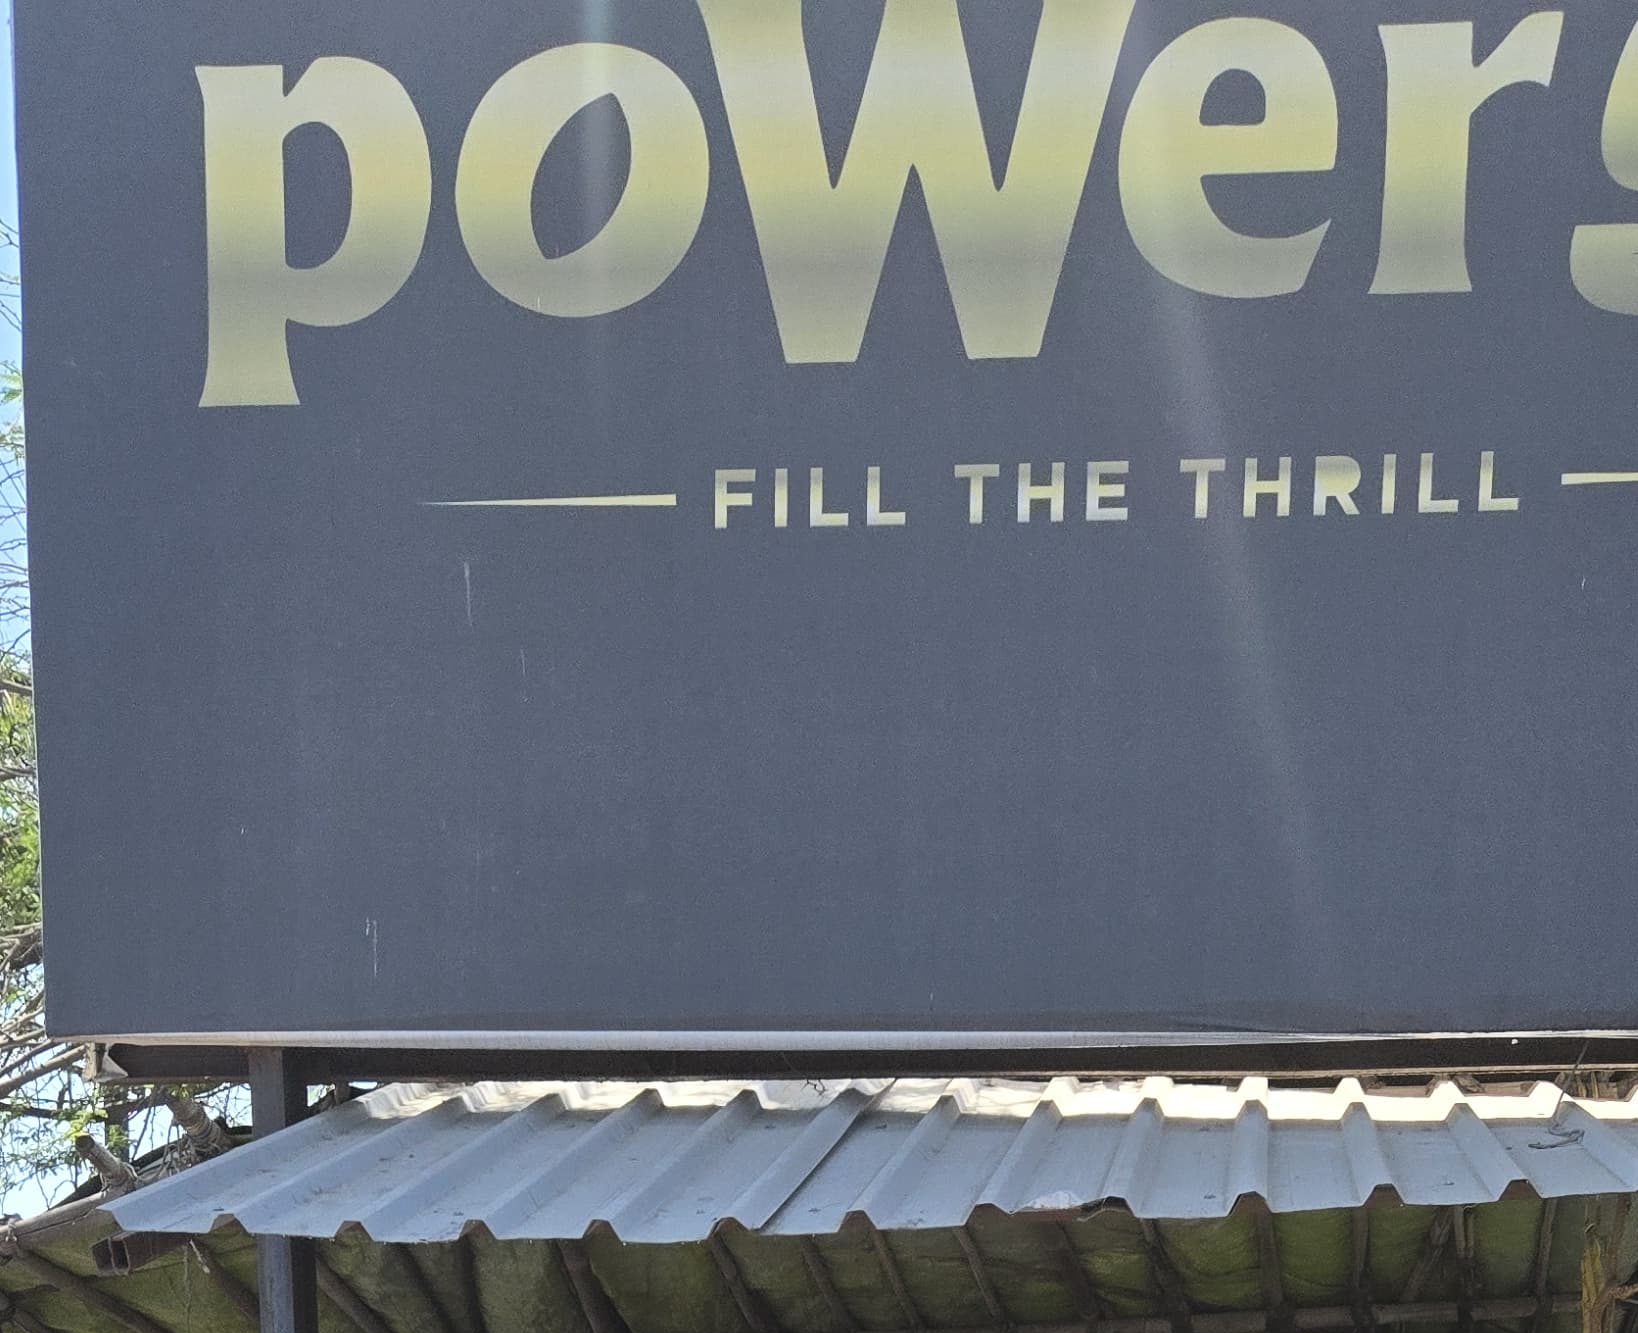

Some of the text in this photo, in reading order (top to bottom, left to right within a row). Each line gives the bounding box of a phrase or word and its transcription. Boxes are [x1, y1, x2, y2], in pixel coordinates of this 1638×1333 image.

[713, 450, 1520, 529] FILL THE THRILL
